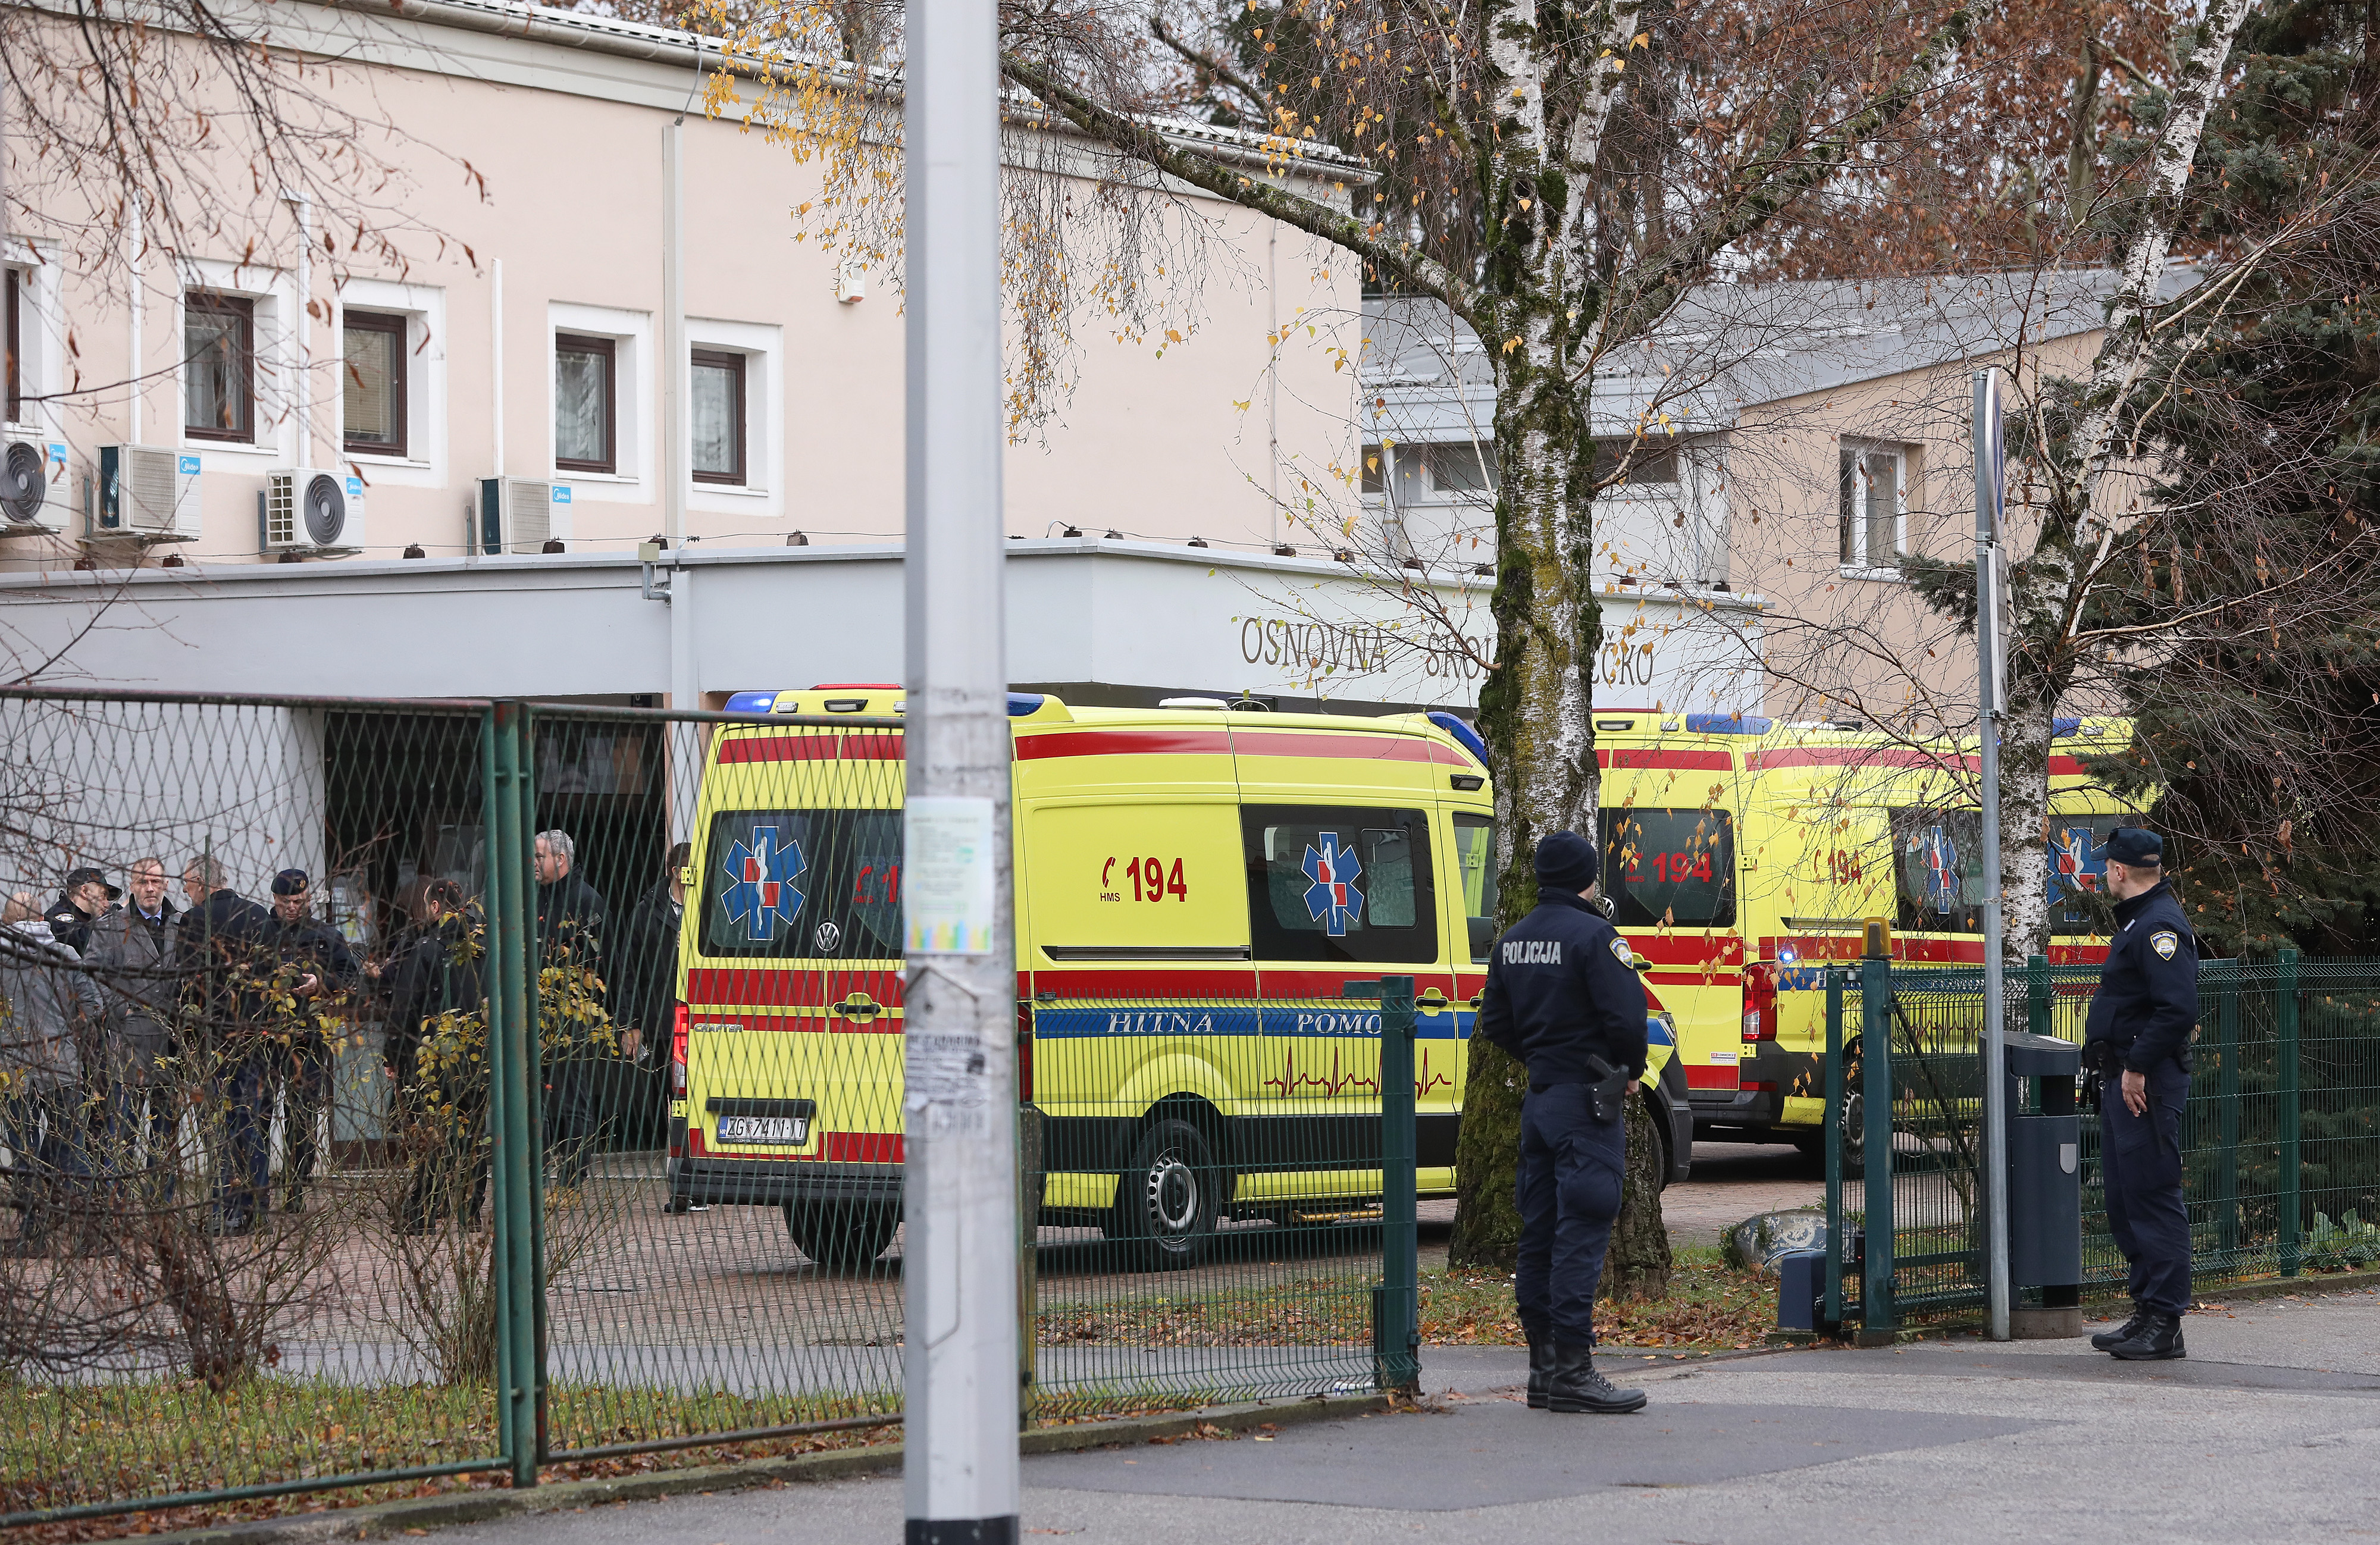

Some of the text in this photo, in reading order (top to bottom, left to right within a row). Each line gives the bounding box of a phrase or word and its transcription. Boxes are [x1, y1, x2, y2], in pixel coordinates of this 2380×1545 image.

[182, 460, 199, 471] Midea
[555, 490, 569, 500] Midea
[1242, 618, 1387, 673] OSNOVNA
[1652, 853, 1712, 883] 194
[1828, 849, 1862, 885] 194
[1126, 857, 1188, 902] 194
[1100, 892, 1120, 902] HMS
[1502, 941, 1561, 965] POLICIJA
[694, 1024, 743, 1033] CRAFTER
[1107, 1012, 1382, 1035] HITNA POMO
[728, 1118, 745, 1136] ZG
